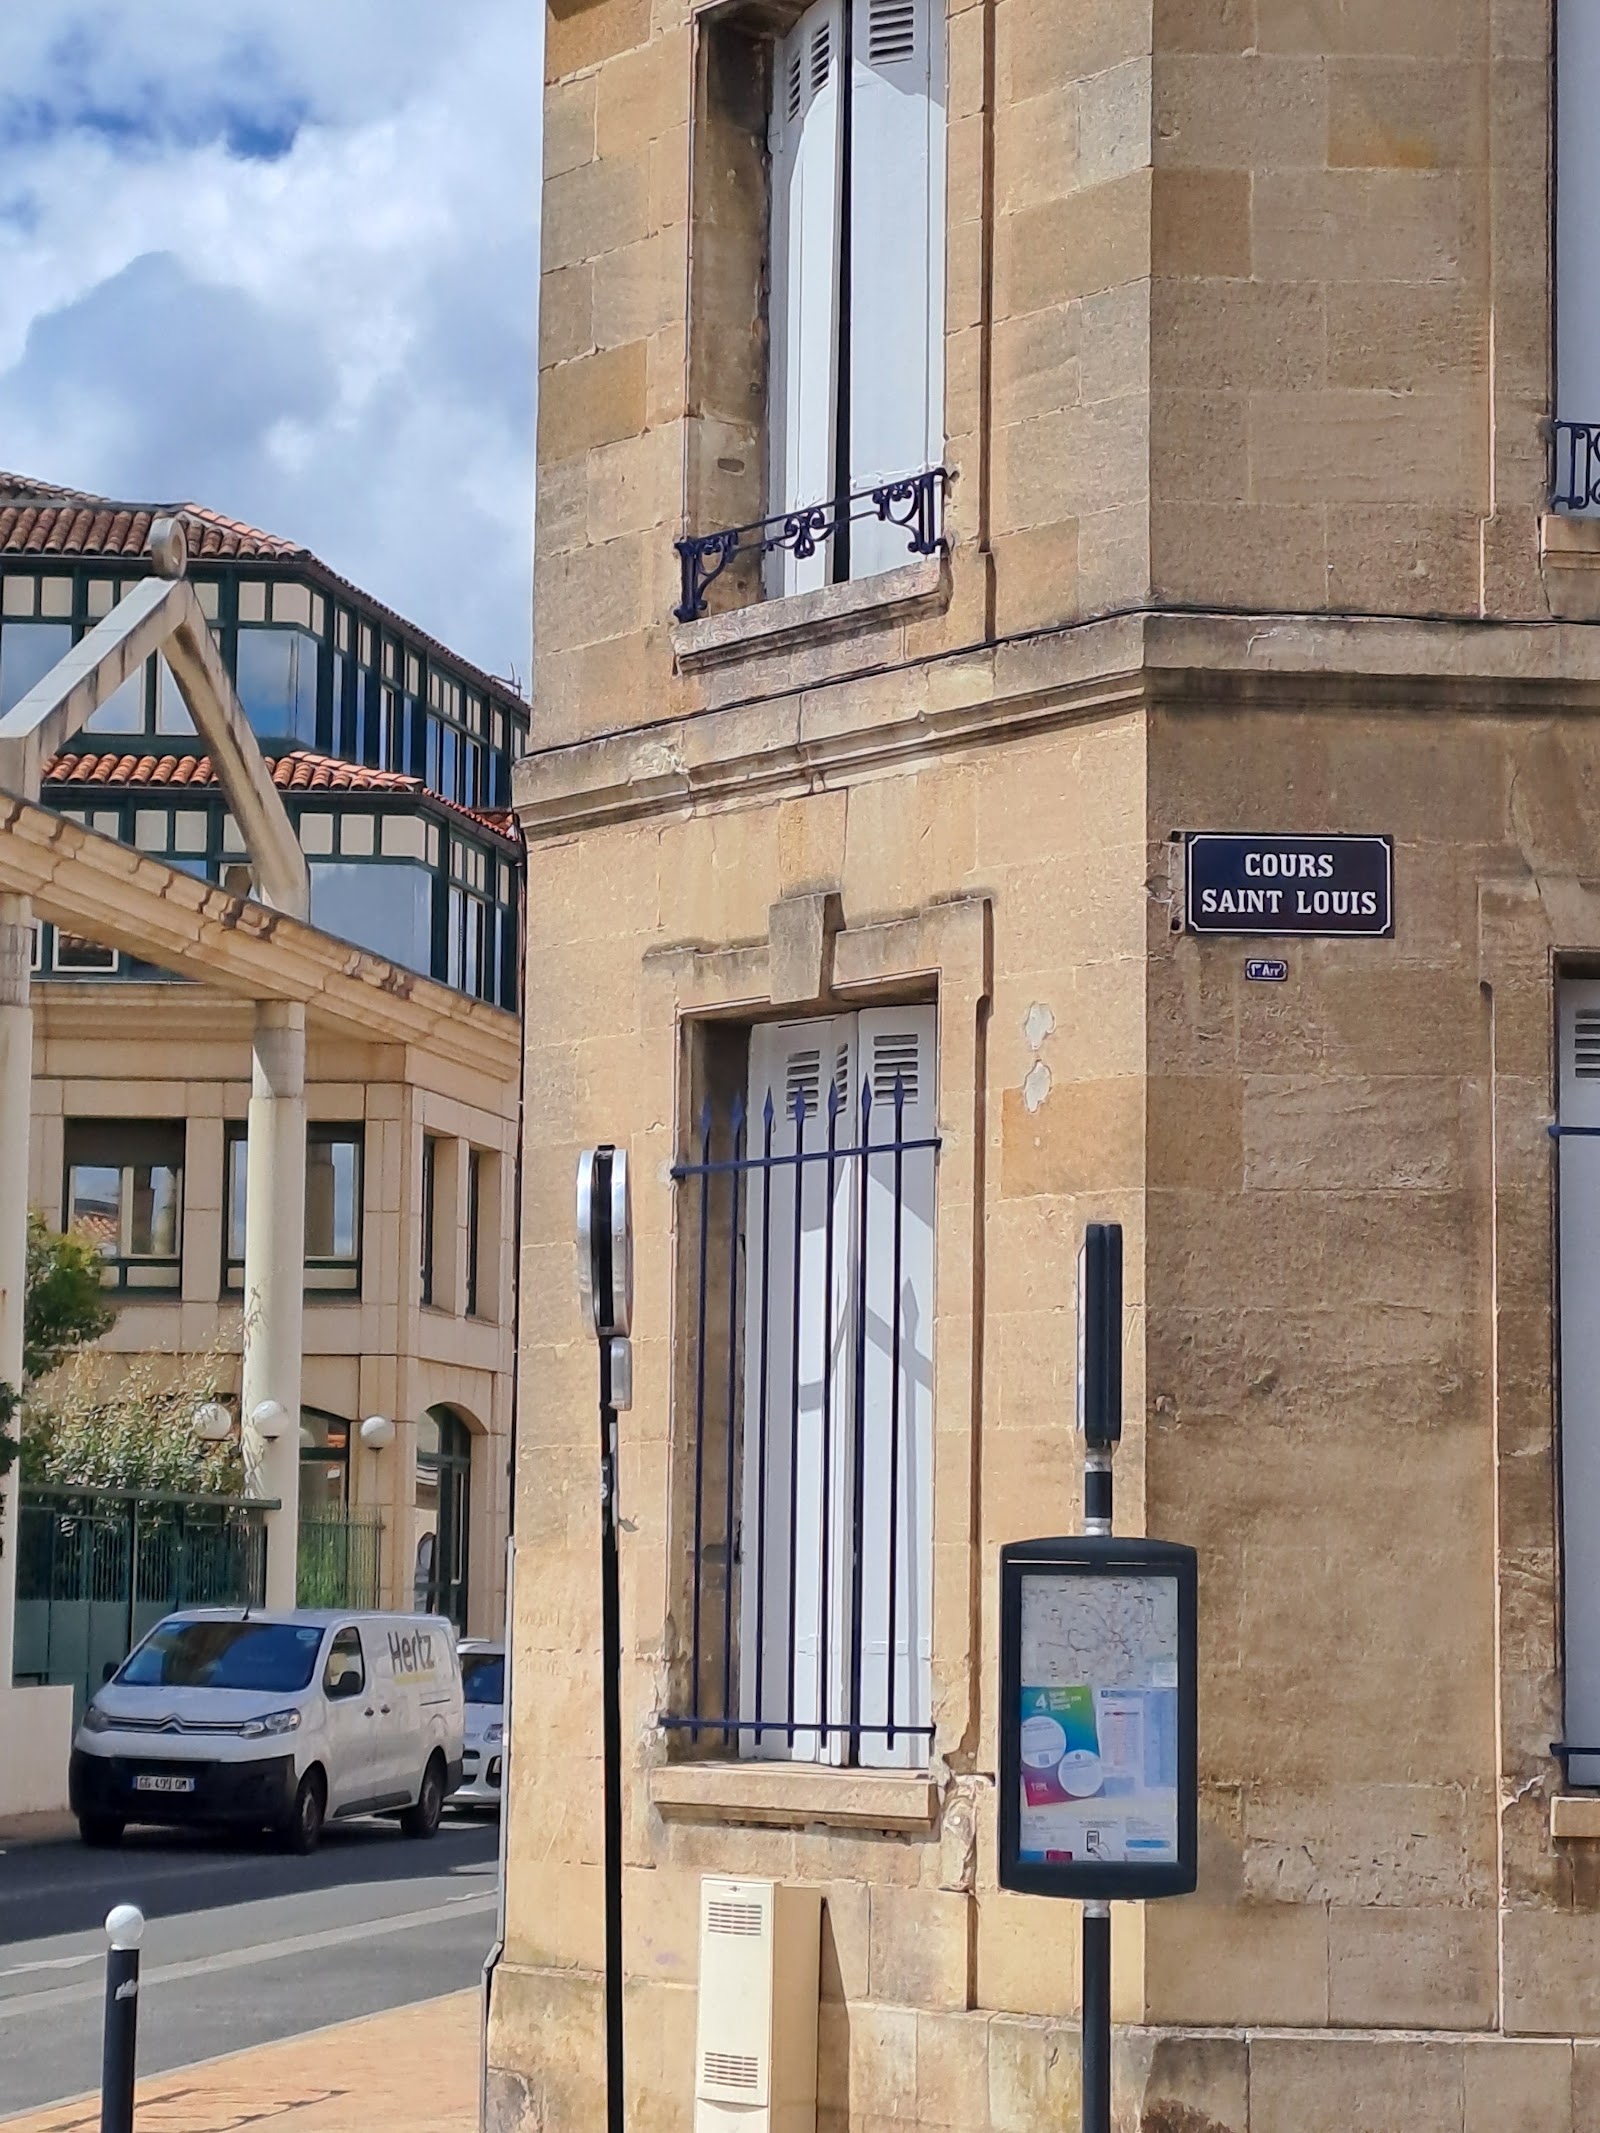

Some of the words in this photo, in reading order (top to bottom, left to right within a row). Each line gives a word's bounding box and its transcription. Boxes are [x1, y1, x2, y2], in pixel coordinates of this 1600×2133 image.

[1244, 852, 1334, 878] COURS
[1201, 888, 1283, 914] SAINT
[1296, 890, 1377, 915] LOUIS
[387, 1628, 435, 1675] Hertz
